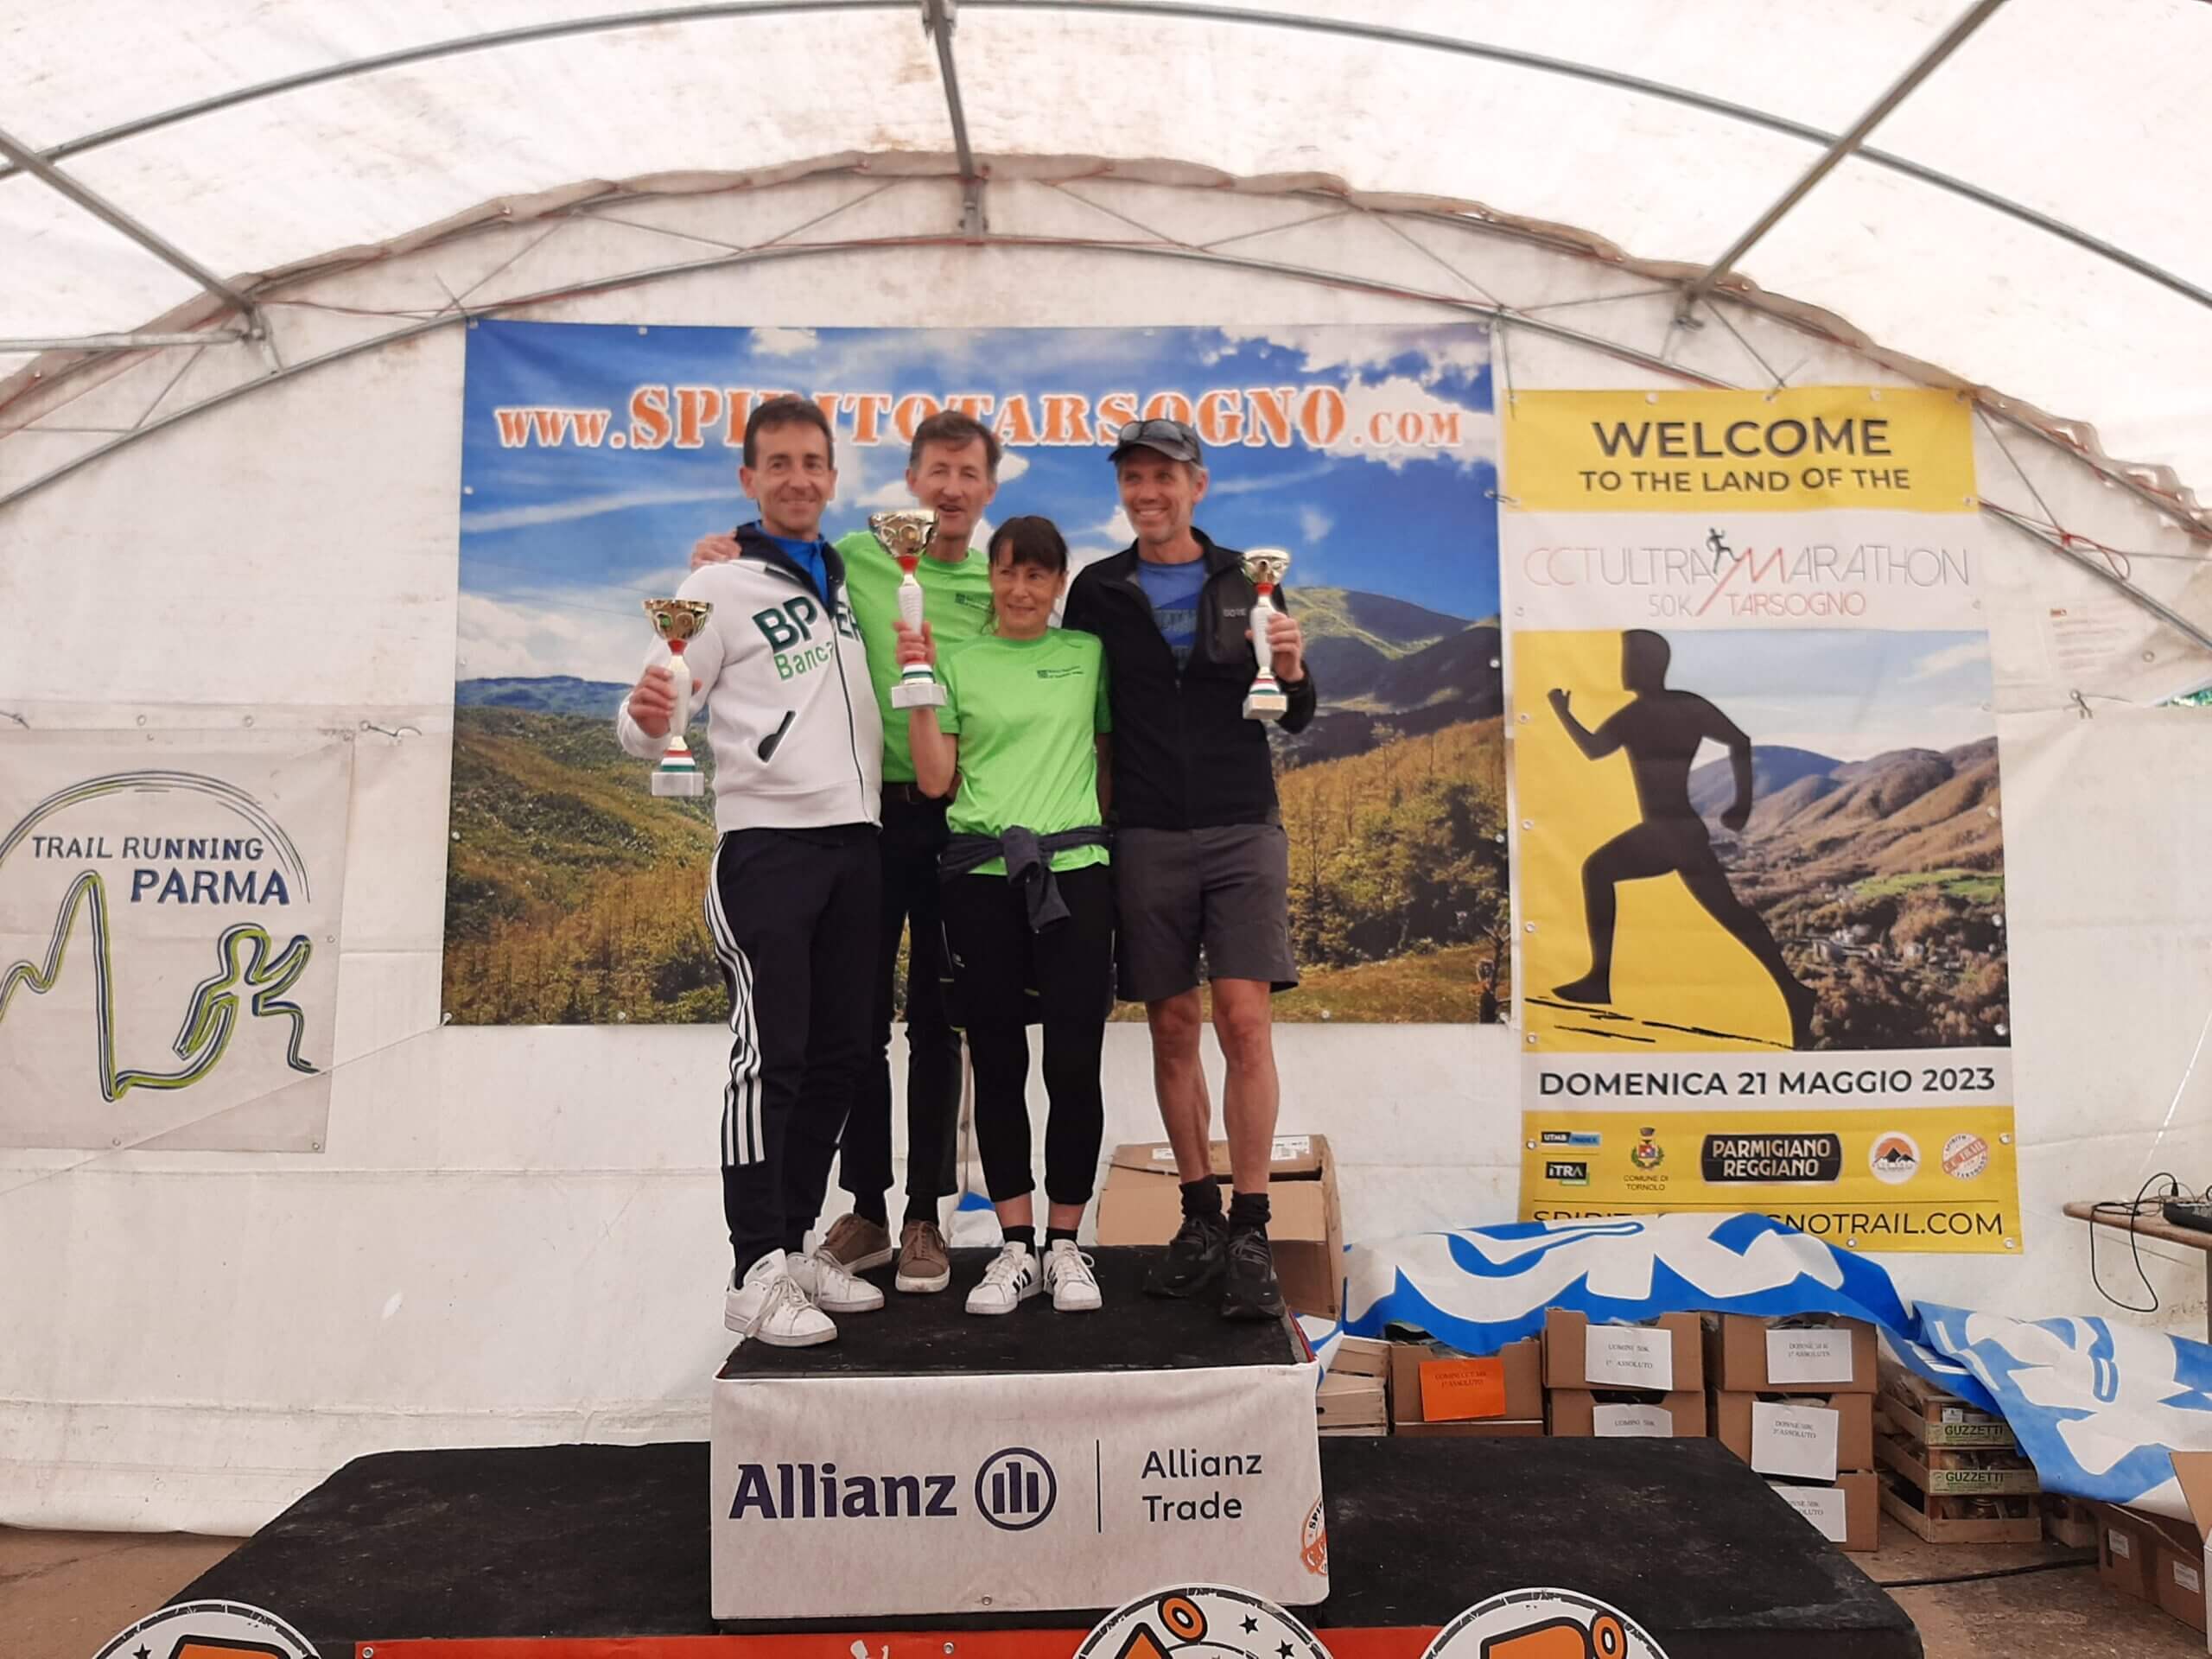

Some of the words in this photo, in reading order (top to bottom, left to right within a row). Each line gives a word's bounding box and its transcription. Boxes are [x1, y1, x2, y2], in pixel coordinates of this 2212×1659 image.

[1591, 416, 1892, 459] WELCOME
[1580, 470, 1621, 492] TO
[1630, 471, 1691, 493] THE
[1702, 470, 1790, 493] LAND
[1801, 467, 1843, 490] OF
[1852, 467, 1910, 490] THE
[1648, 594, 1694, 617] 50K
[1728, 591, 1867, 616] TARSOGNO
[32, 836, 113, 859] TRAIL
[122, 836, 265, 861] RUNNING
[130, 868, 291, 906] PARMA
[1539, 1071, 1727, 1096] DOMENICA
[1737, 1071, 1767, 1096] 21
[1777, 1068, 1912, 1096] MAGGIO
[1923, 1066, 1995, 1092] 2023
[1543, 1133, 1567, 1141] UTMB
[1712, 1138, 1831, 1160] PARMIGIANO
[1723, 1158, 1820, 1179] REGGIANO
[1944, 1425, 2003, 1435] GUZZETTI
[1141, 1449, 1263, 1480] Allianz
[1945, 1472, 2003, 1483] GUZZETTI
[729, 1462, 958, 1520] Allianz
[1141, 1491, 1243, 1522] Trade
